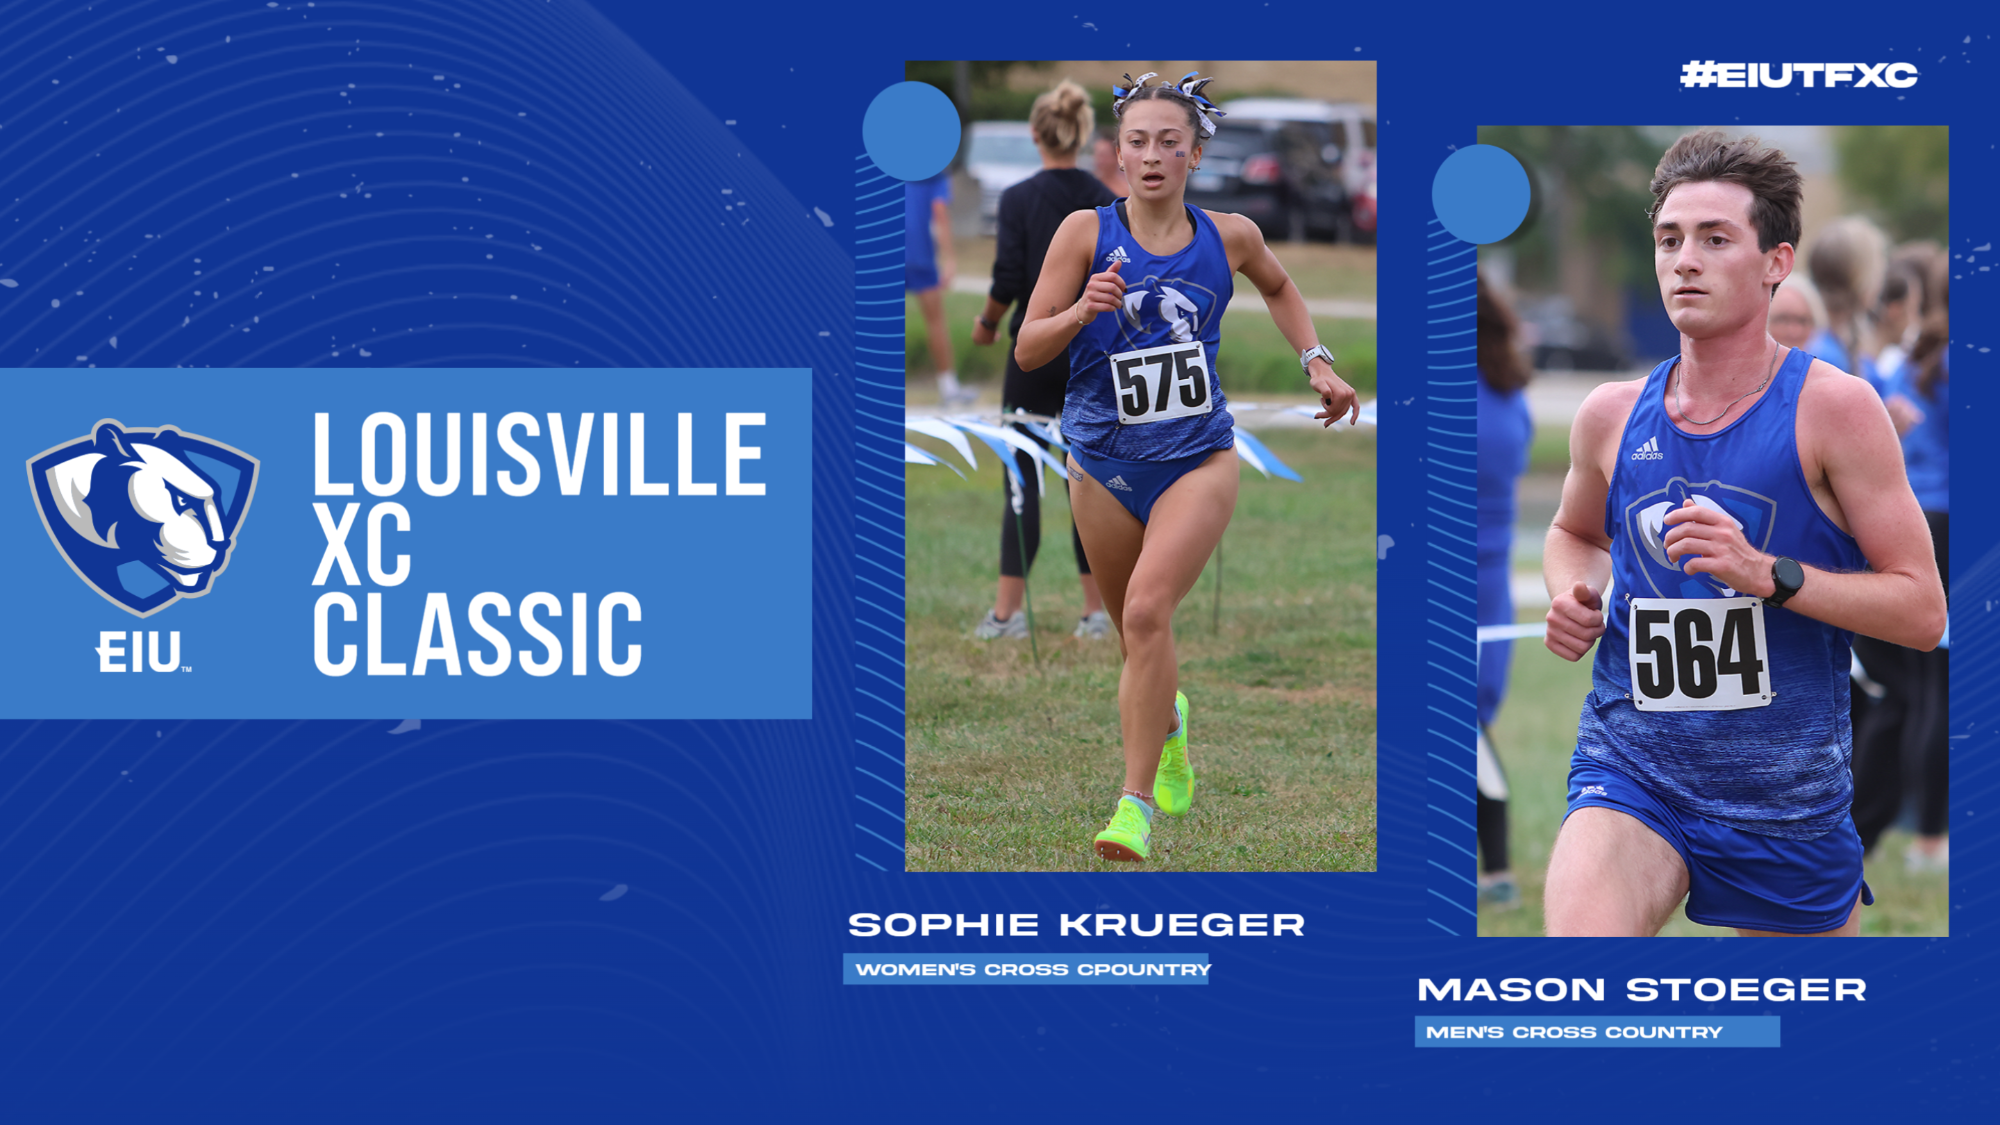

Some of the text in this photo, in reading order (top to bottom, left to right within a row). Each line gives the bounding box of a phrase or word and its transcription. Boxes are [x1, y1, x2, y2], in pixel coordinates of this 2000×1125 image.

[1116, 348, 1207, 417] 575
[1631, 451, 1664, 461] adidas
[1634, 607, 1764, 699] 564
